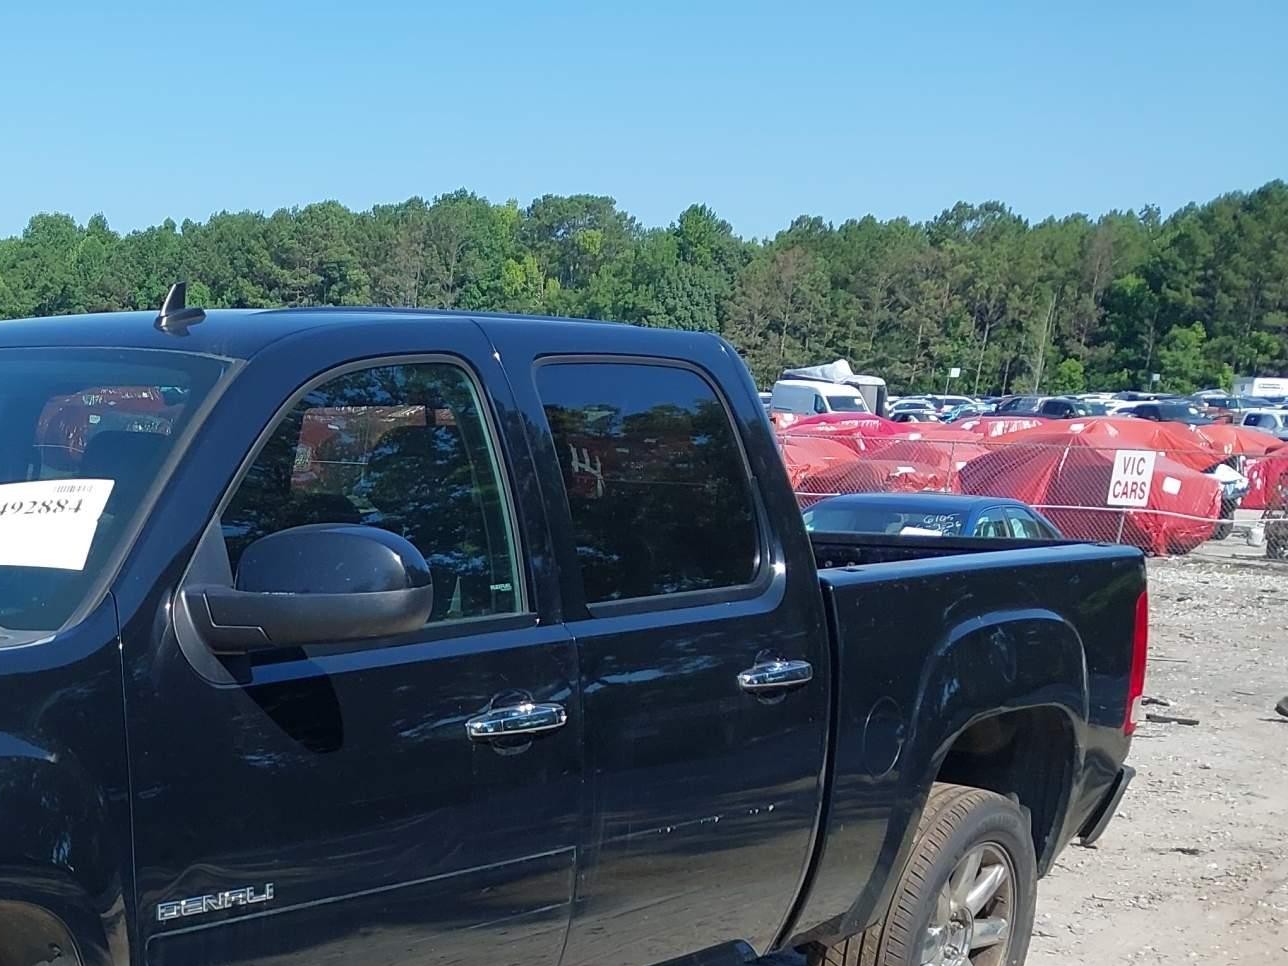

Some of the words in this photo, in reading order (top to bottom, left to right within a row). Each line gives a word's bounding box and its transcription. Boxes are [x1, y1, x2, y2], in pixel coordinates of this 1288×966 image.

[1122, 456, 1146, 476] VIC
[1112, 480, 1147, 500] CARS
[156, 883, 274, 921] DENALI
